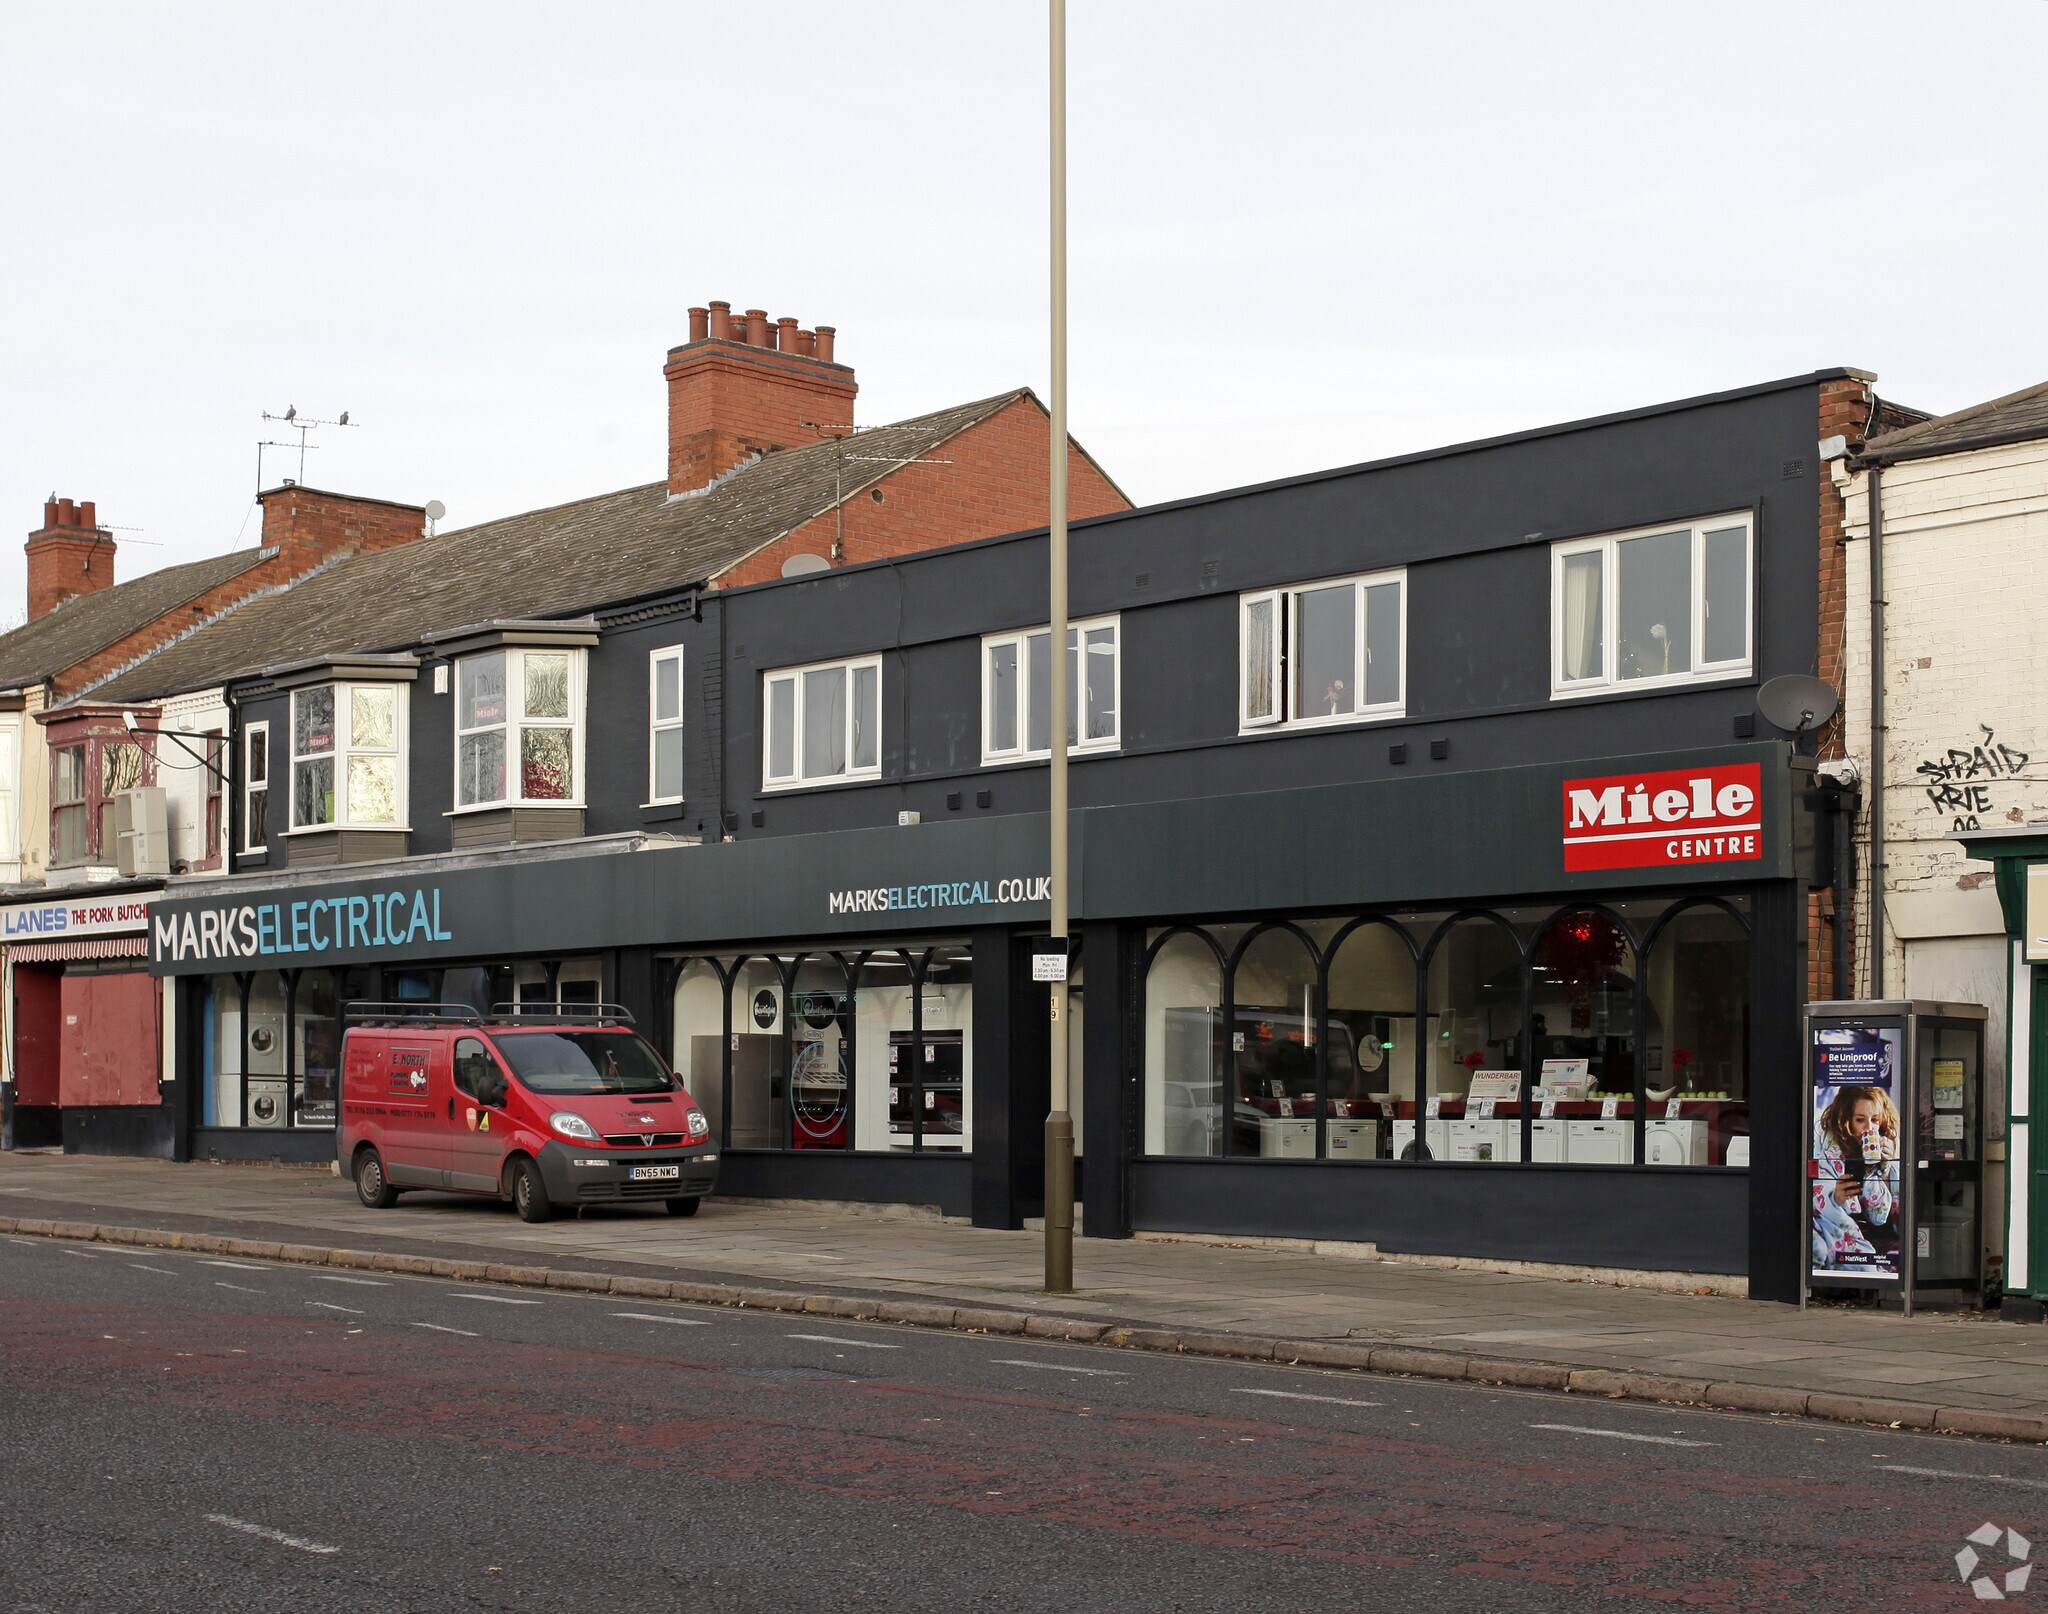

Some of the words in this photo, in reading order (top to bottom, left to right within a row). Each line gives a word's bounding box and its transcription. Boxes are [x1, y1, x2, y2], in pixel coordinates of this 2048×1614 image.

[477, 709, 498, 718] Miele
[310, 738, 329, 748] Miele
[1568, 778, 1754, 828] Miele
[1666, 836, 1754, 859] CENTRE
[6, 907, 67, 934] LANES
[72, 909, 86, 925] THE
[90, 906, 114, 924] PORK
[155, 888, 452, 962] MARKSELECTRICAL
[1051, 1010, 1056, 1019] 9
[402, 1054, 426, 1066] NORTH
[1828, 1053, 1839, 1062] Be
[1840, 1052, 1878, 1063] Uniproof
[636, 1168, 658, 1178] BN55
[660, 1168, 676, 1178] NWC
